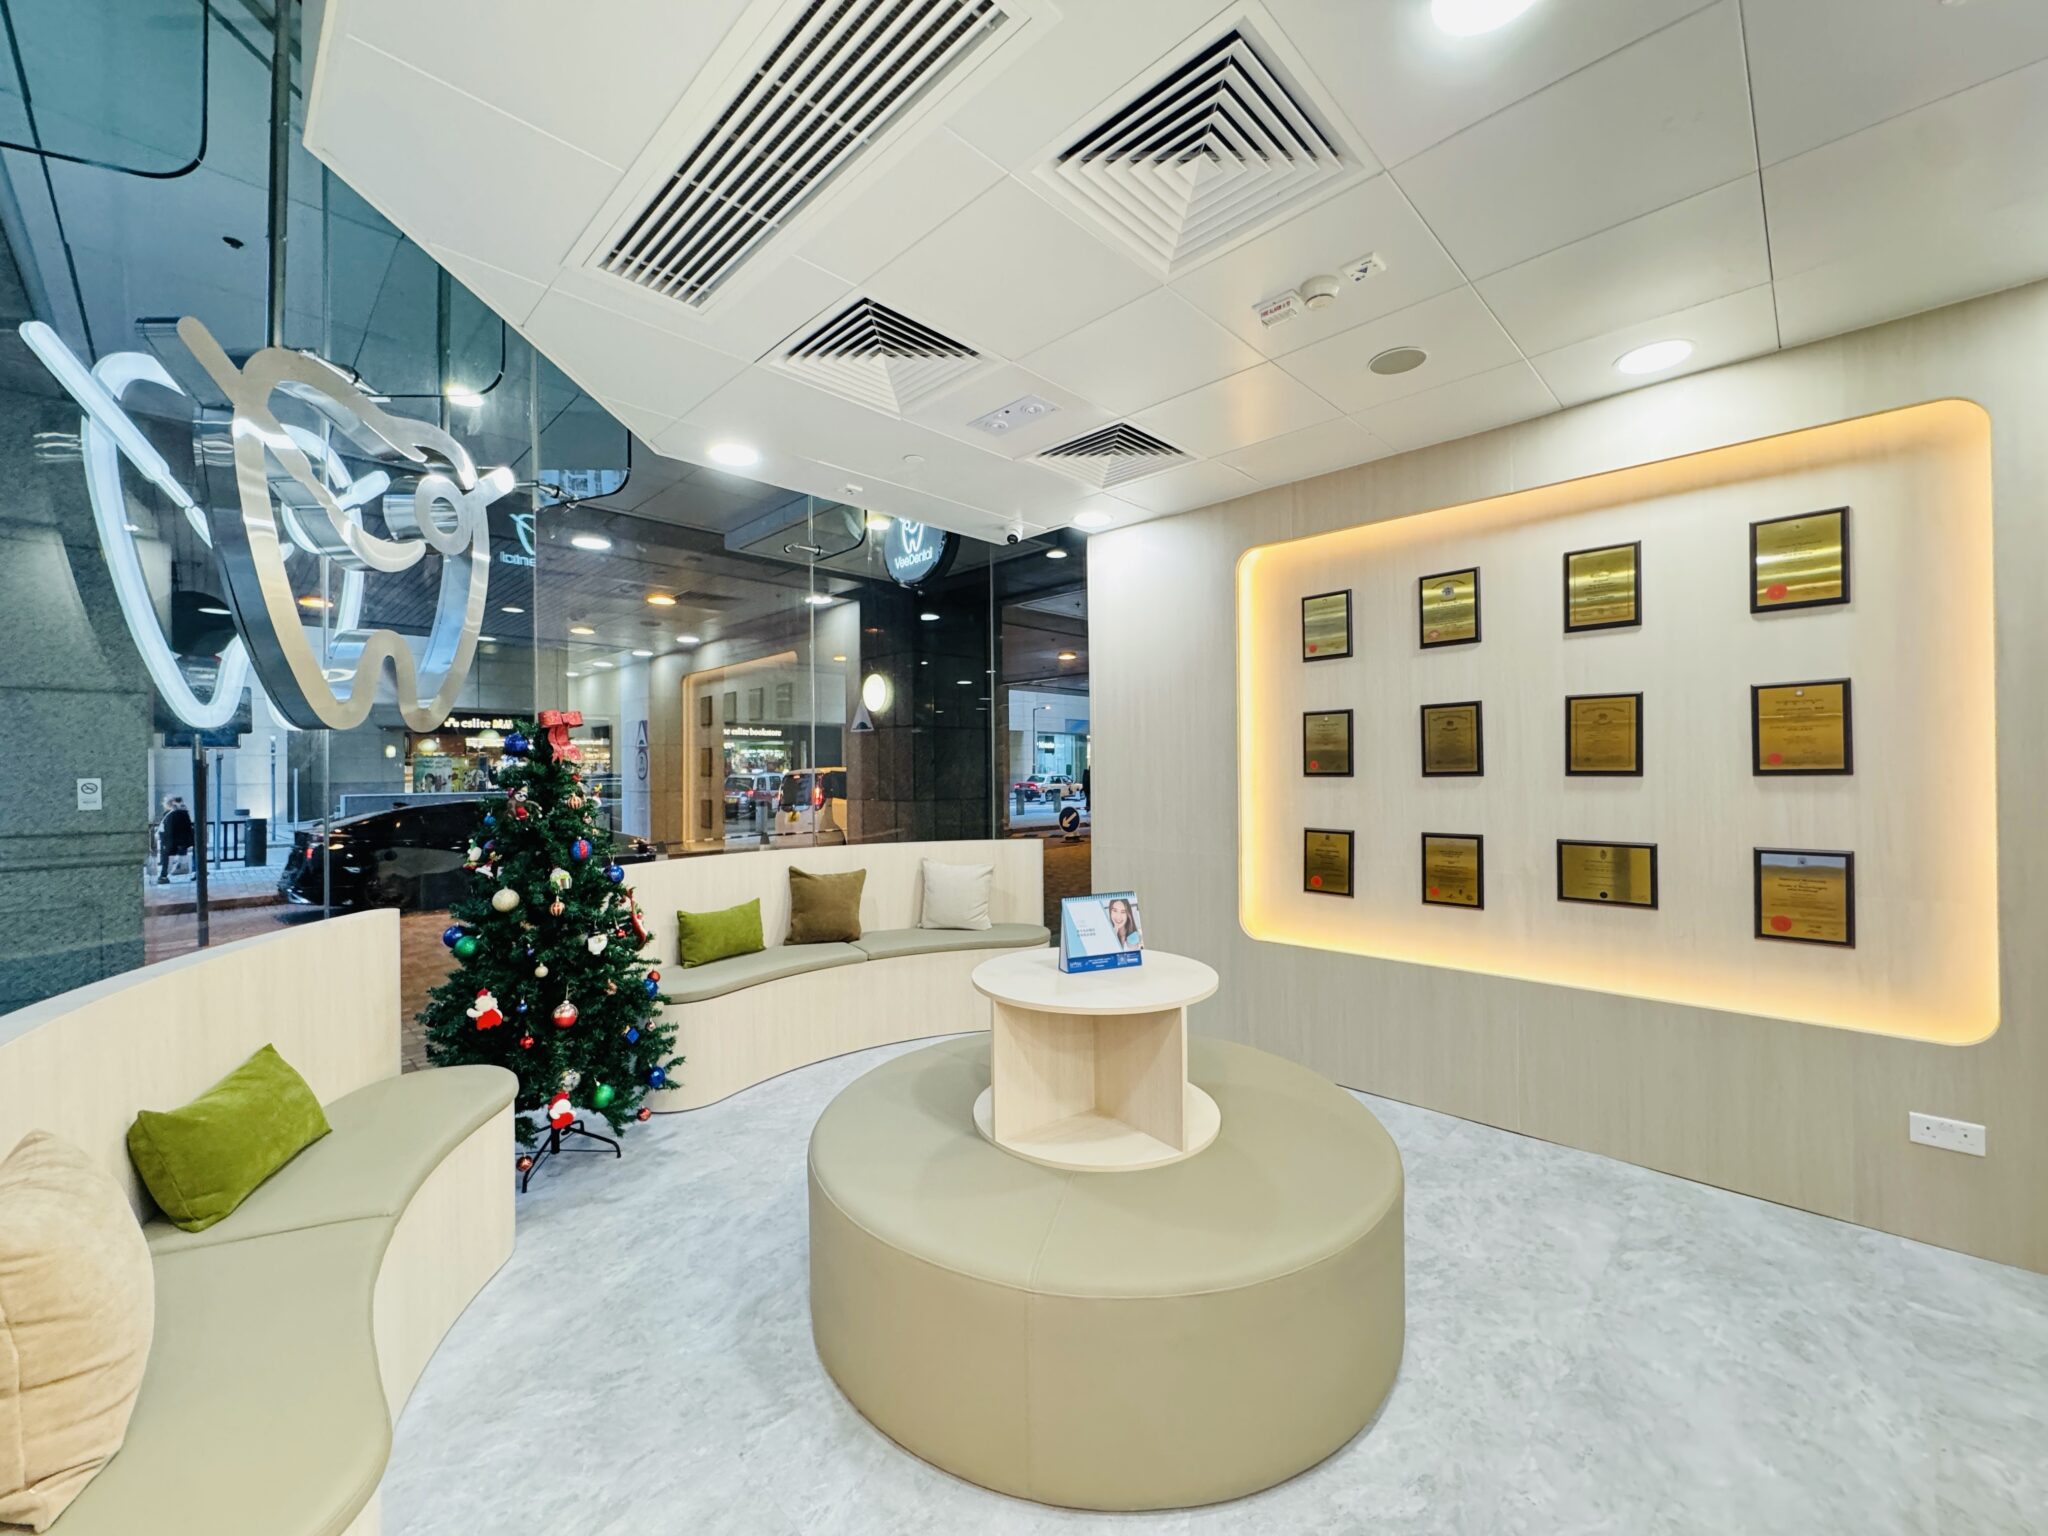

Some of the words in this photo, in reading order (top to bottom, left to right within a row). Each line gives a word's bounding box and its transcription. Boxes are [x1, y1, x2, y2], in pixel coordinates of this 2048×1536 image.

[894, 546, 933, 570] VeeDental
[461, 717, 491, 729] eslite
[749, 727, 782, 737] bookstore
